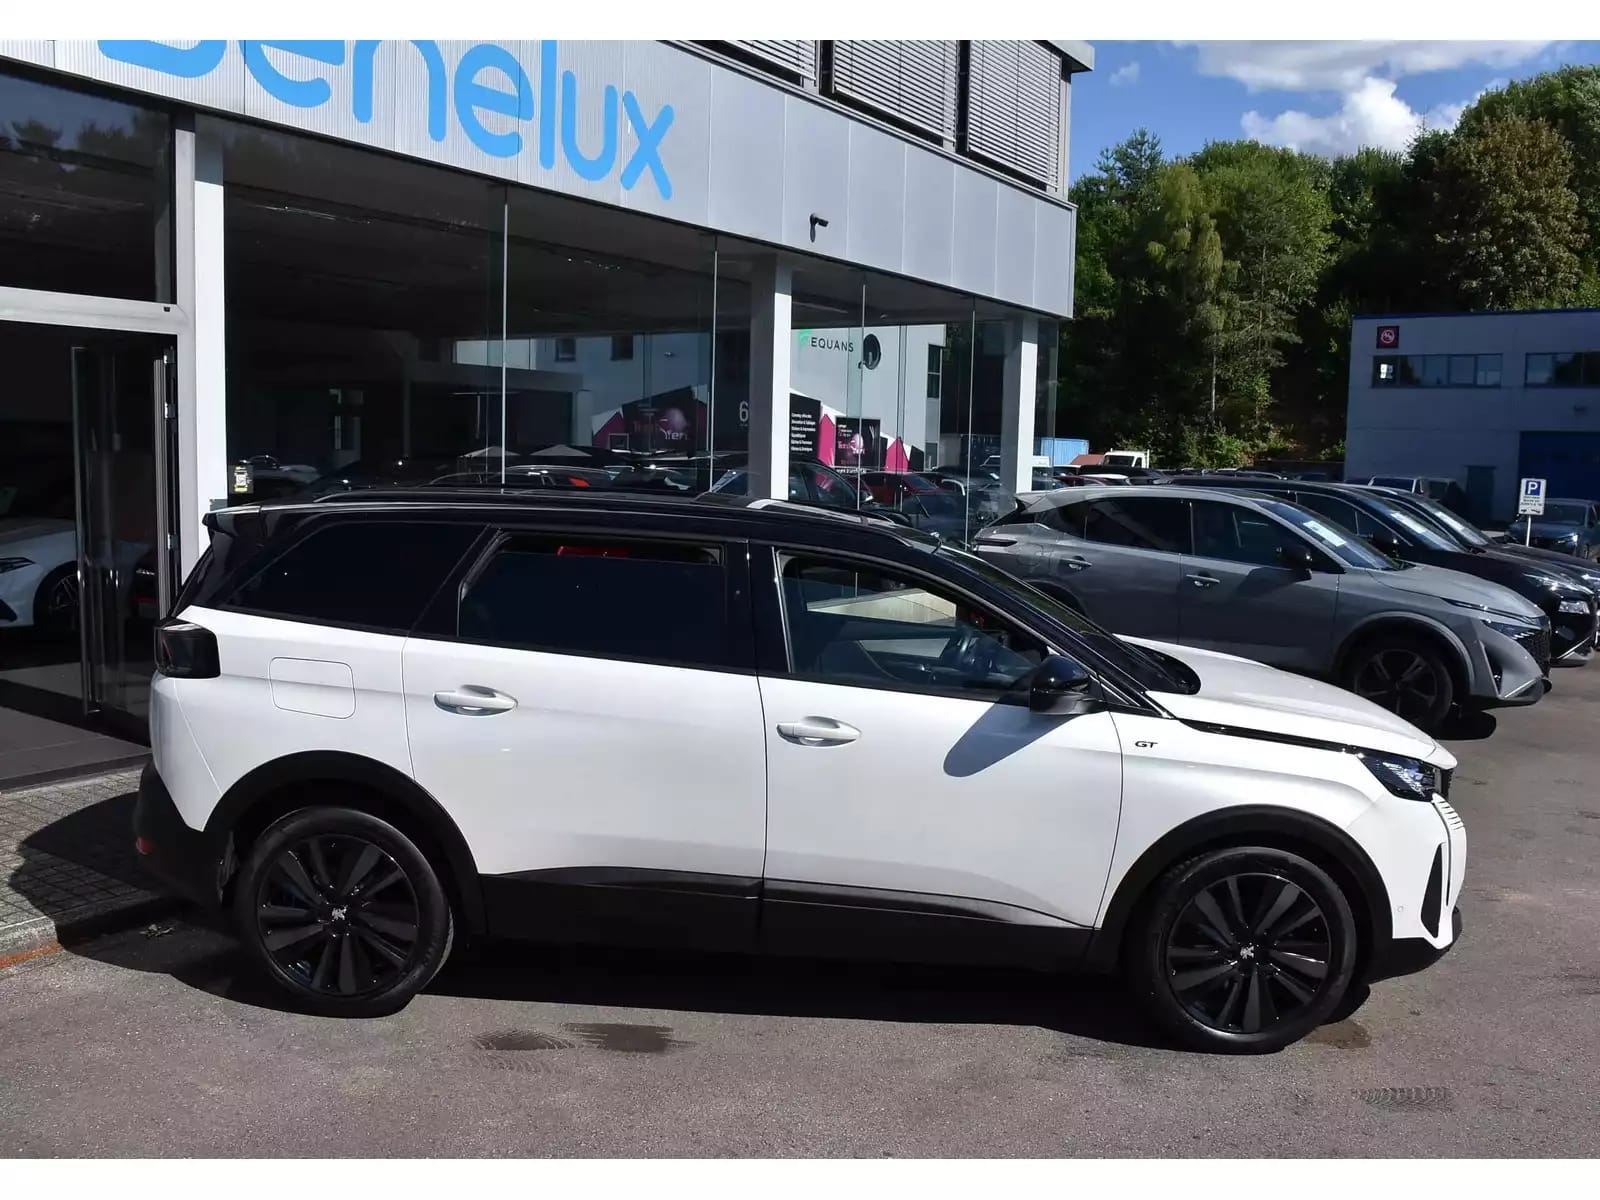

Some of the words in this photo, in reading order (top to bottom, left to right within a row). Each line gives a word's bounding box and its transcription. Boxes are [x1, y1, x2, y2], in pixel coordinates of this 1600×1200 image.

[97, 40, 675, 200] enelux
[810, 337, 855, 353] EQUANS
[1527, 481, 1538, 495] P
[1135, 740, 1158, 748] GT
